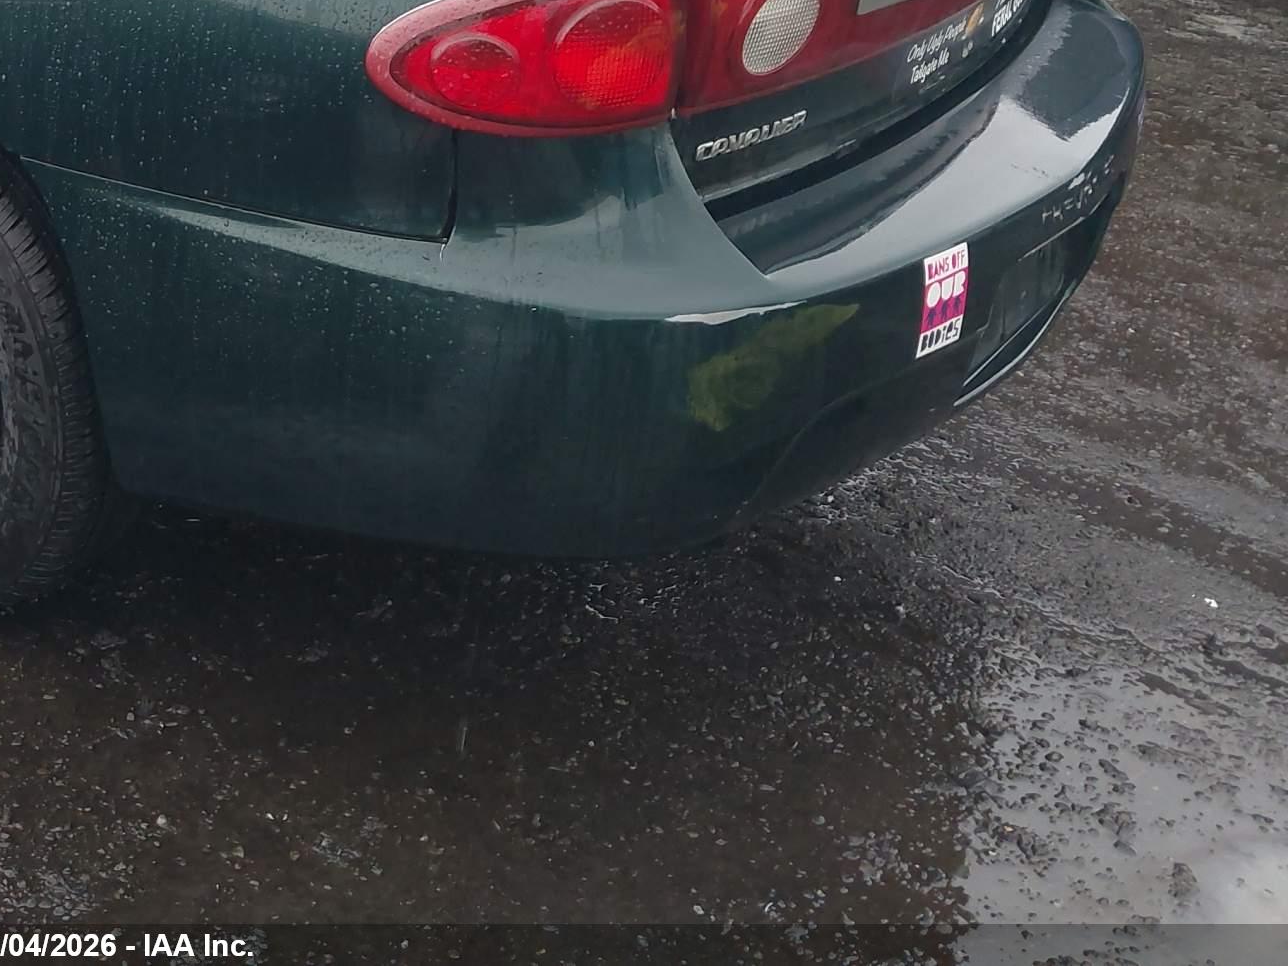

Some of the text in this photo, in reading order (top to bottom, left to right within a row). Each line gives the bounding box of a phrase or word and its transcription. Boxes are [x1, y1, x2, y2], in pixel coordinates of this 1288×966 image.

[907, 39, 927, 63] Only
[696, 110, 807, 161] CAVALIER
[928, 249, 966, 280] BANS OFF
[926, 270, 967, 308] OUR
